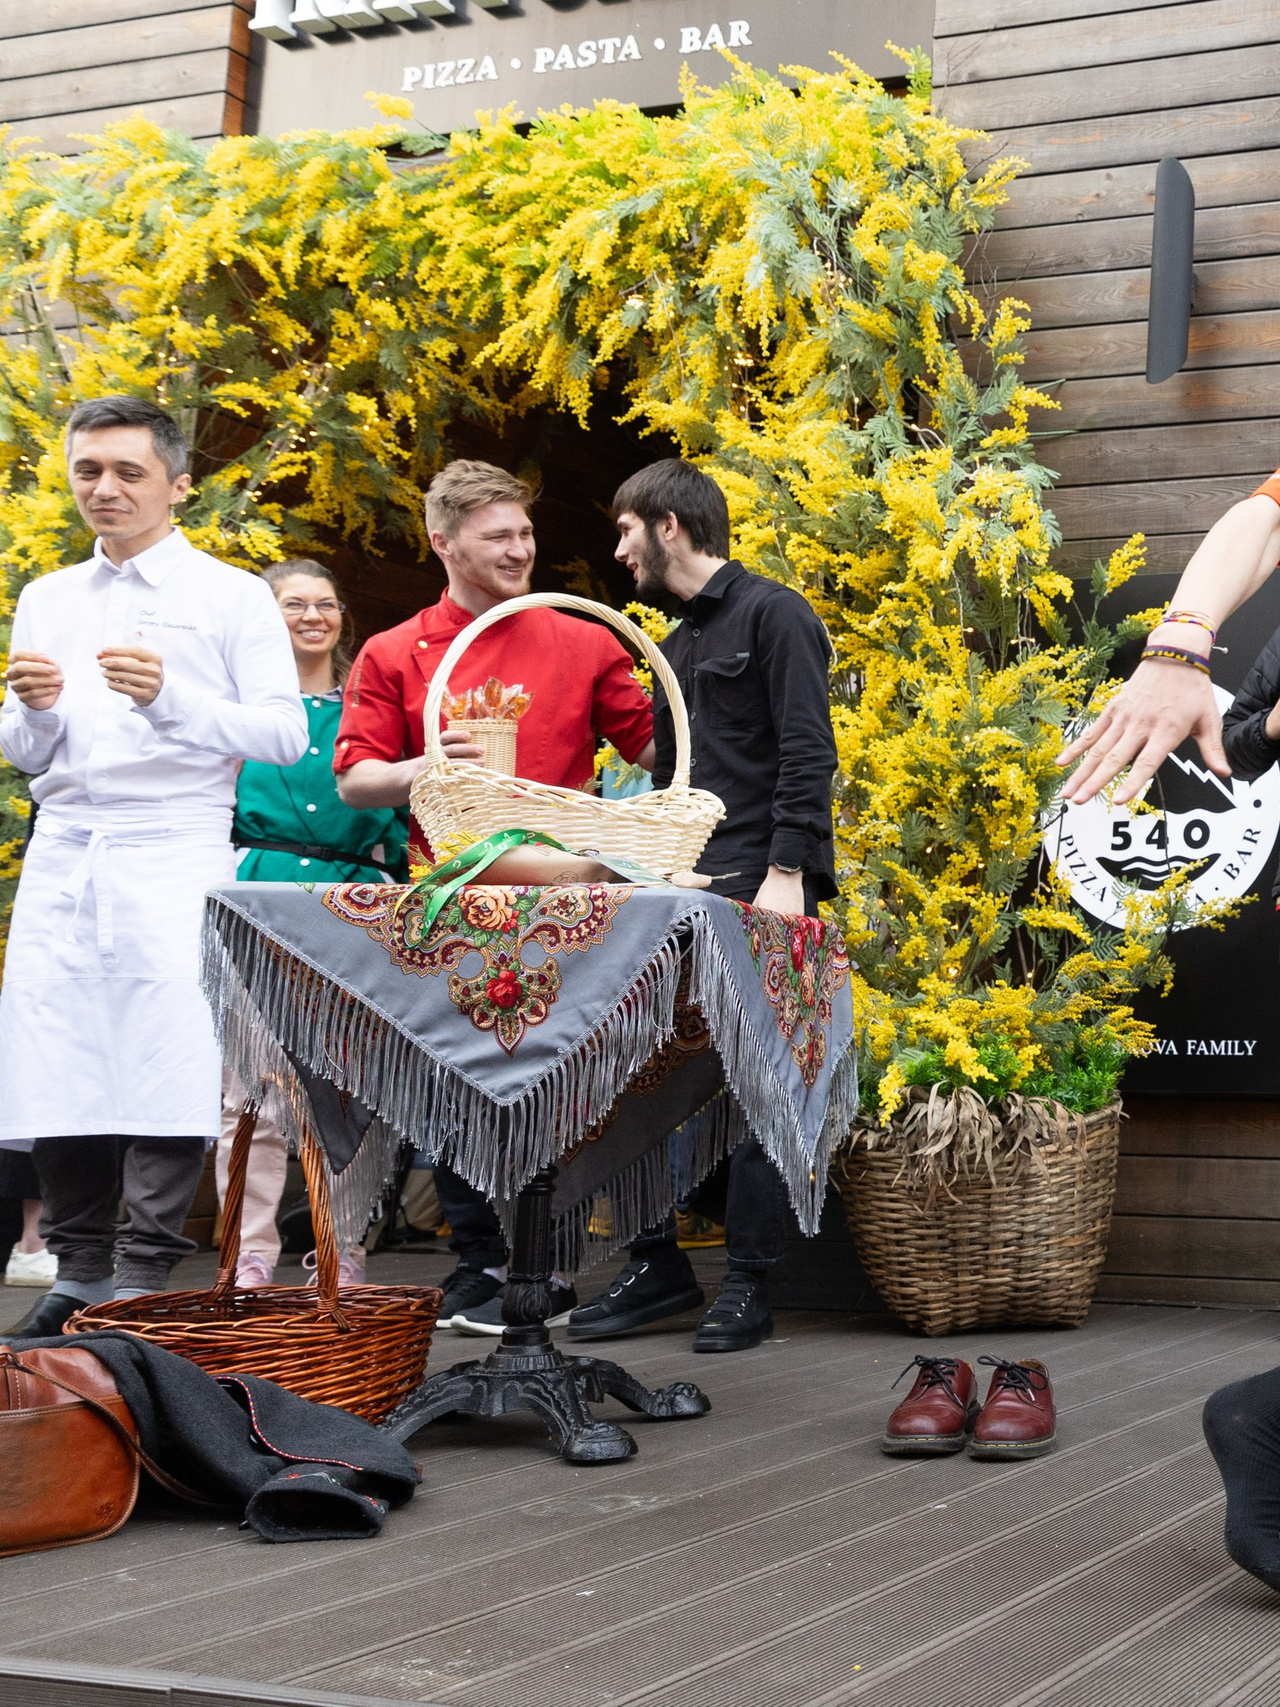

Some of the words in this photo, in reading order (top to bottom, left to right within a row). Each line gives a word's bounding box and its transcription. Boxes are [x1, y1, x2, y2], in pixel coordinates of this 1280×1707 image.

[402, 54, 499, 92] PIZZA
[533, 34, 643, 74] PASTA
[679, 20, 753, 54] BAR
[1110, 818, 1211, 851] 540
[1060, 833, 1107, 903] PIZZA
[1223, 828, 1262, 881] BAR
[1186, 1039, 1257, 1056] FAMILY
